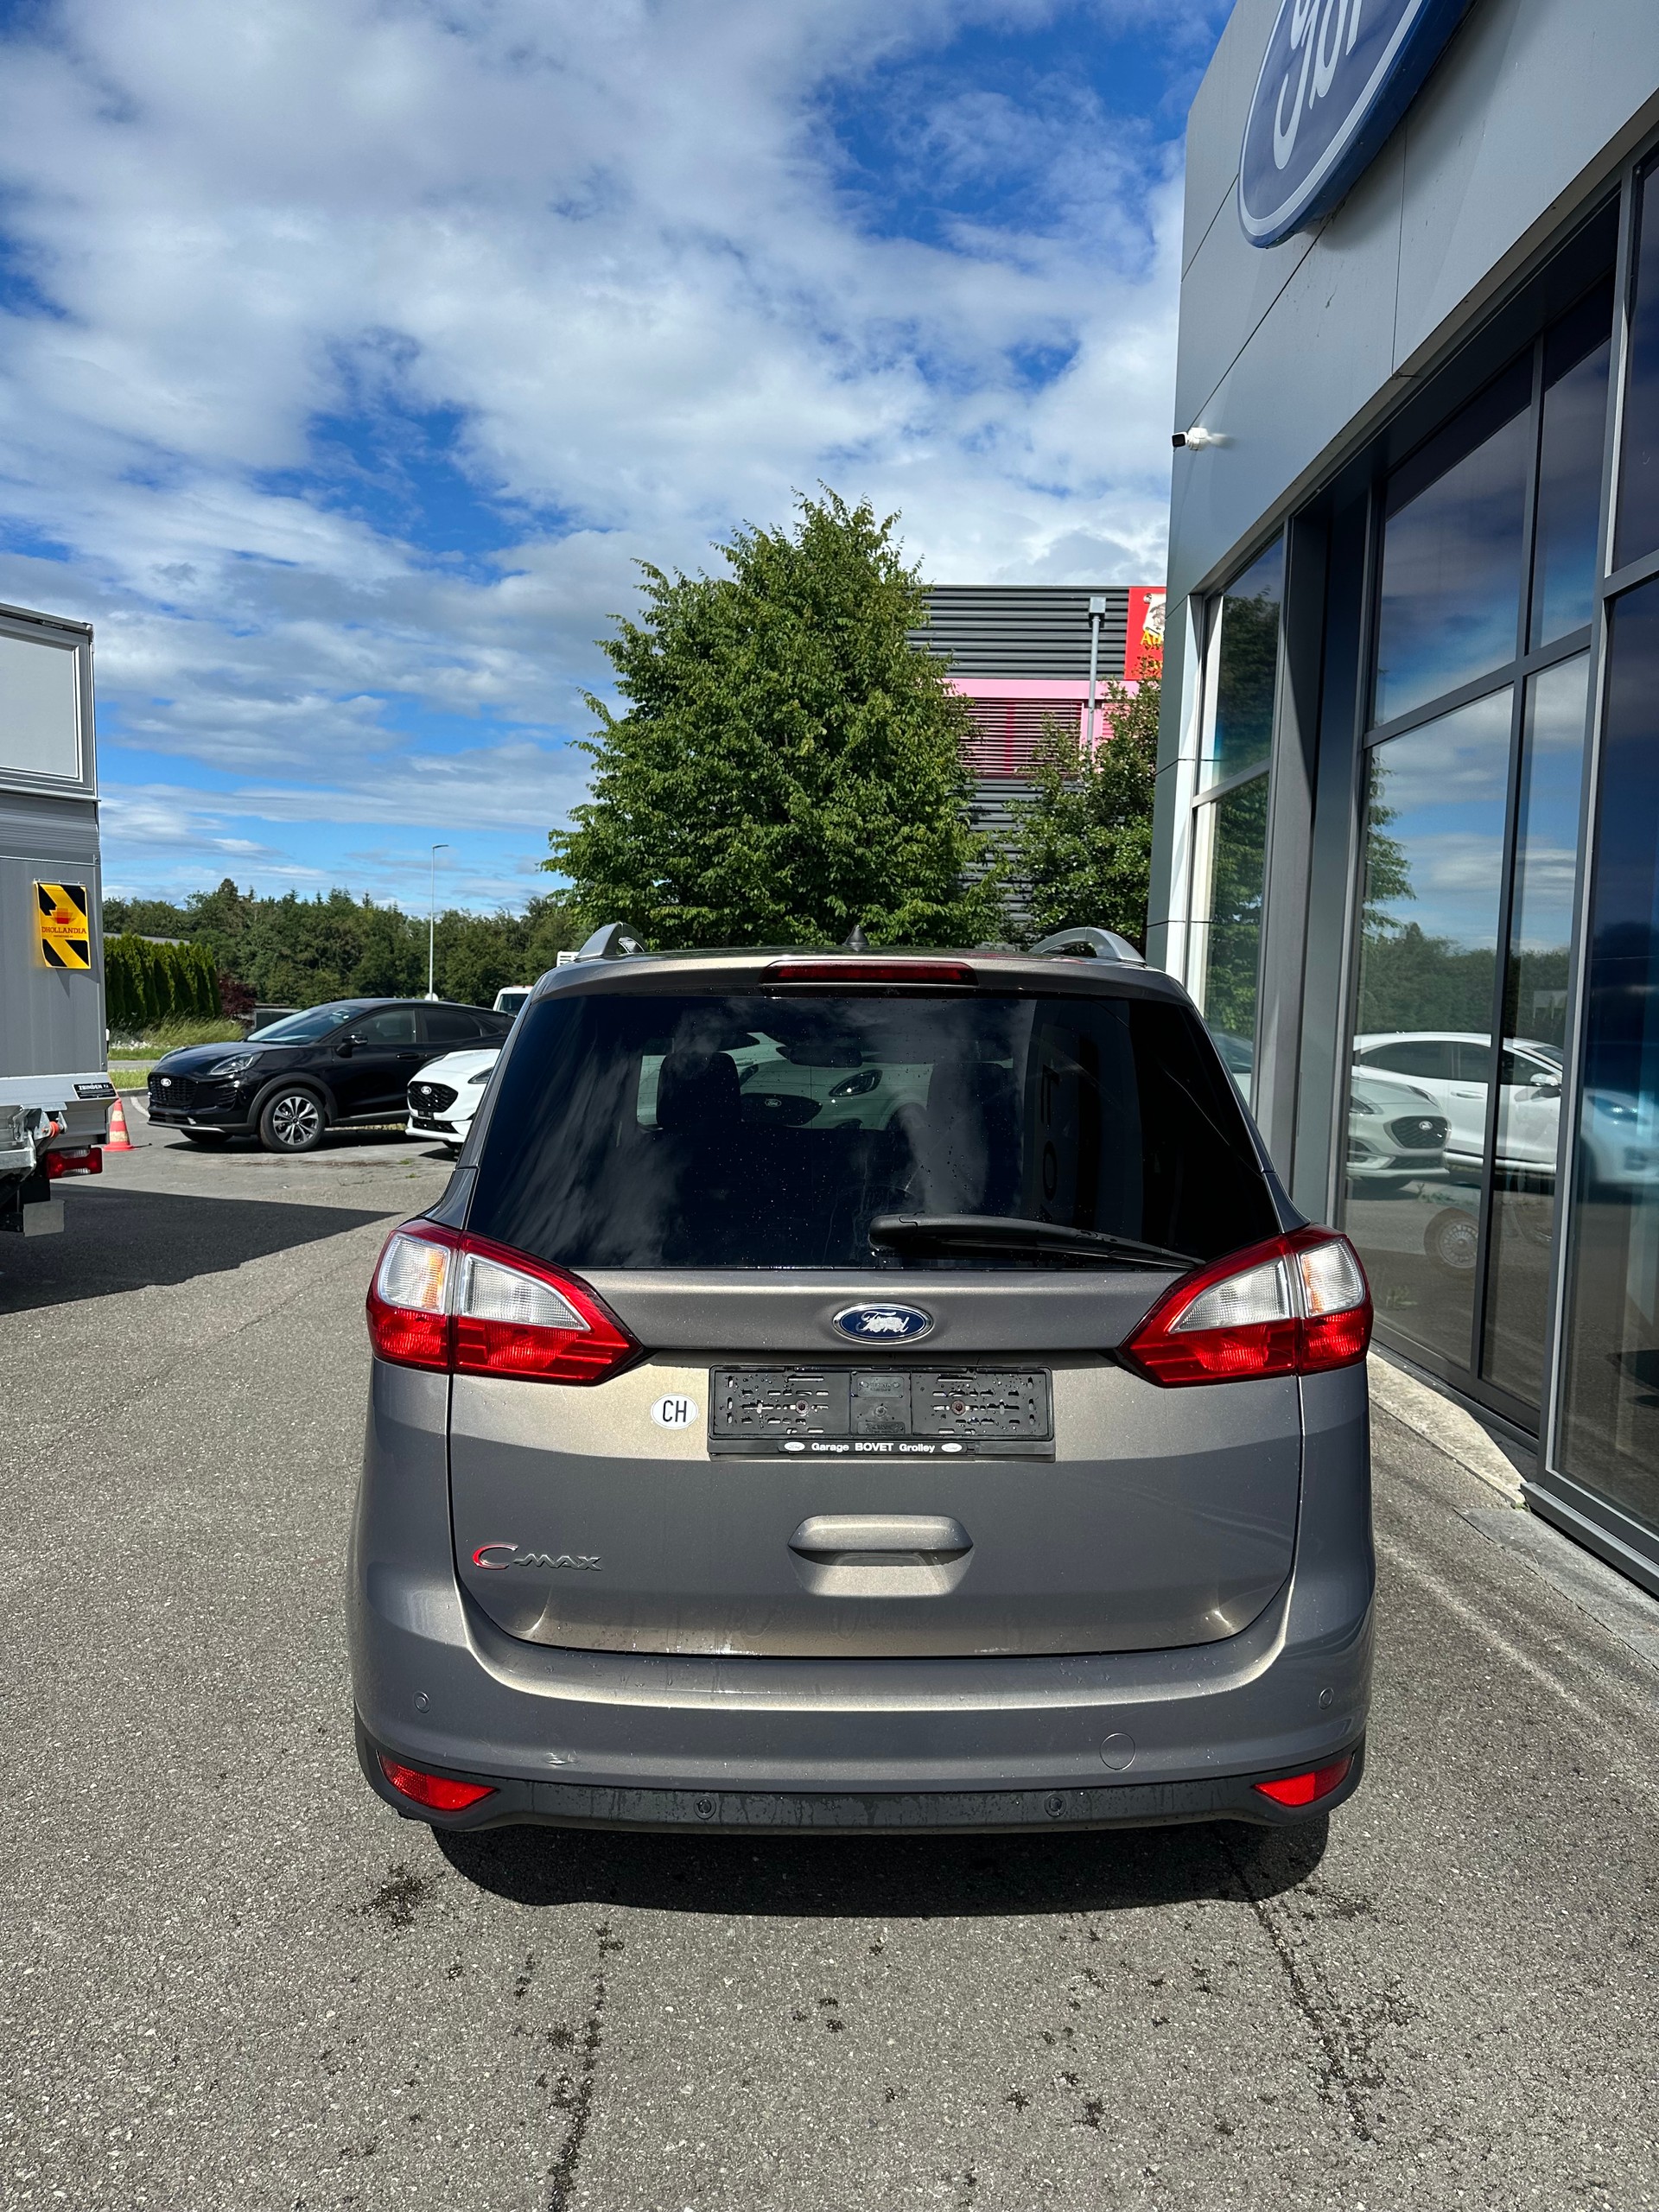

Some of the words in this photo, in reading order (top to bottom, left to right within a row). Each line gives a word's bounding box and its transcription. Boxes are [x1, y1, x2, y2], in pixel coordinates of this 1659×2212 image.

[855, 1311, 910, 1333] Ford
[662, 1400, 687, 1422] CH
[811, 1442, 849, 1452] Garage
[855, 1442, 894, 1452] BOVET
[899, 1443, 936, 1453] Grolley
[472, 1541, 602, 1571] C-MAX
